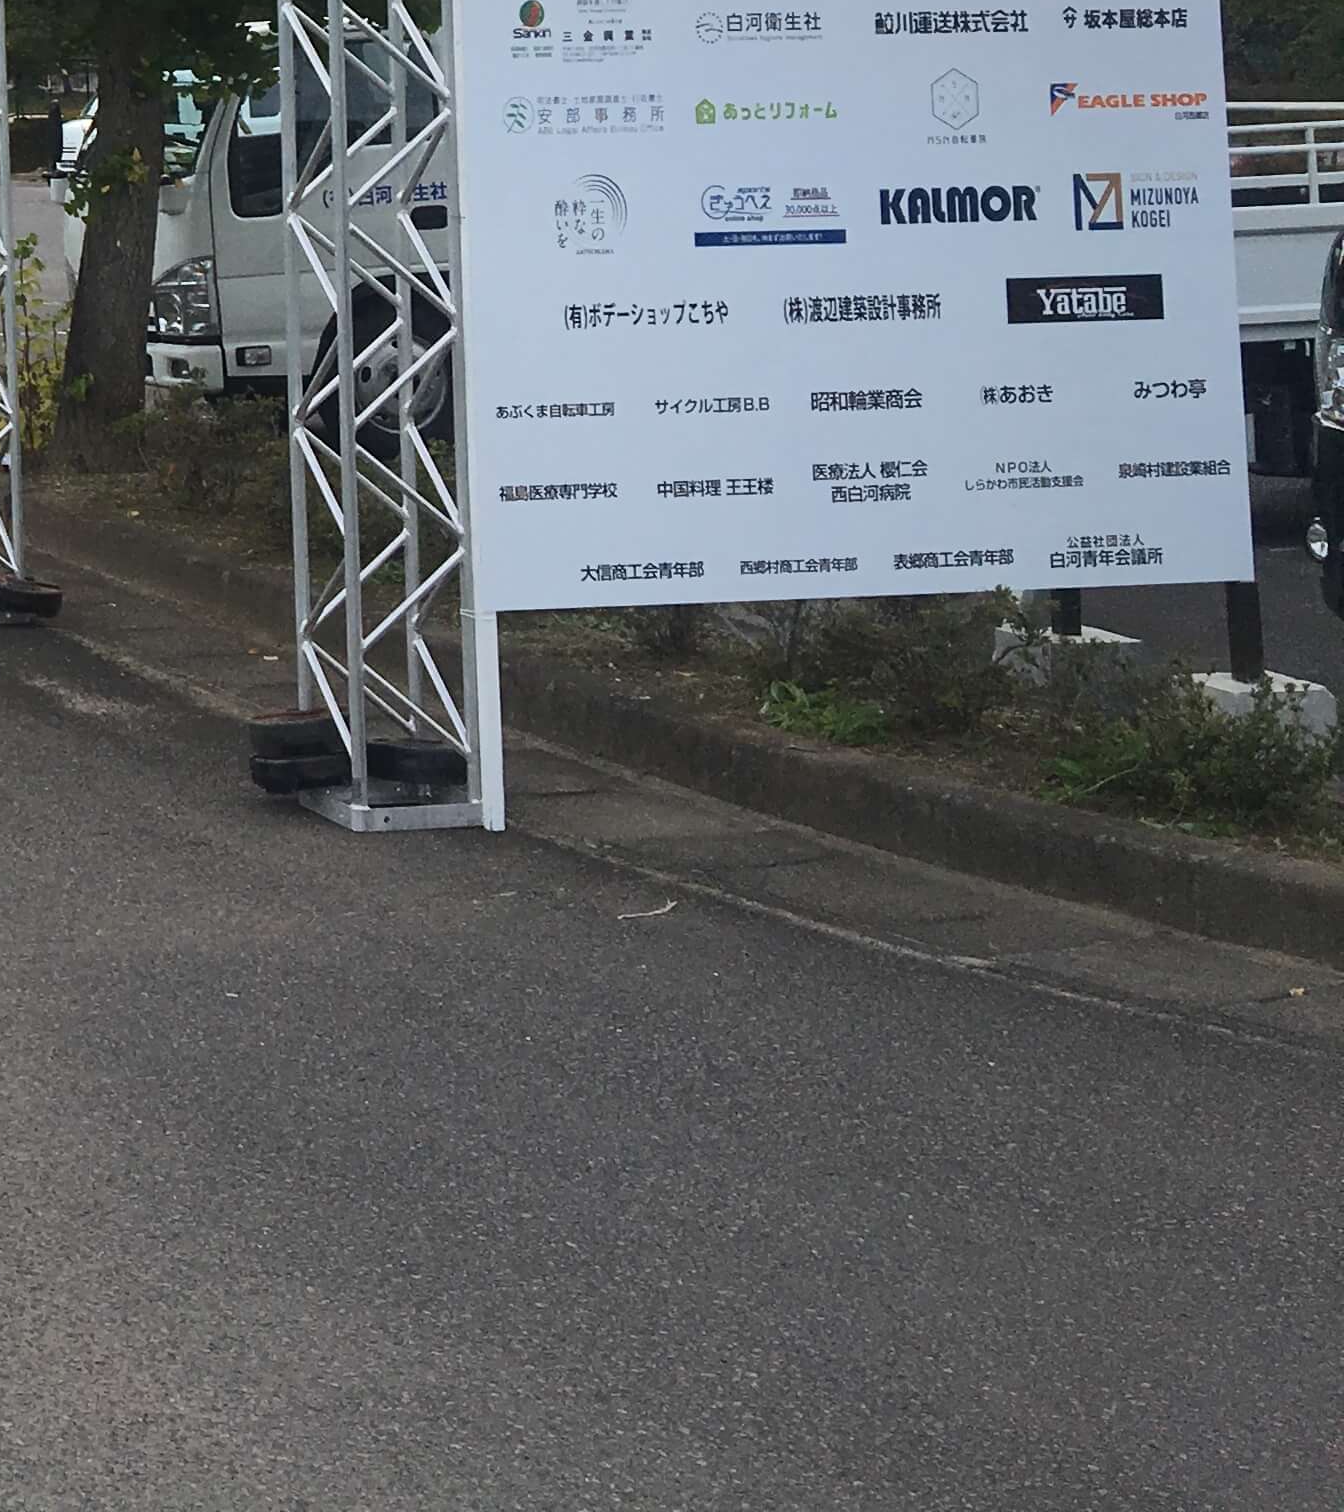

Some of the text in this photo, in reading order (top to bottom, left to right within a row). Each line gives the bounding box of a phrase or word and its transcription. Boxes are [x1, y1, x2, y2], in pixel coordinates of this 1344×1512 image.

[727, 11, 822, 32] 白河衛生社
[723, 101, 838, 120] あっとリフォーム
[1078, 93, 1207, 108] EAGLE SHOP
[879, 185, 1037, 225] KALMOR
[1130, 186, 1199, 206] MIZUNOYA
[1131, 209, 1171, 228] KOGEI
[1036, 286, 1127, 315] Yatabe
[1134, 378, 1207, 399] みつわ亭
[655, 397, 770, 415] サイクル工房B.B
[811, 388, 923, 412] 昭和輪業商会
[496, 402, 615, 419] あぶくま自転車工房
[812, 461, 876, 481] 医療法人
[995, 460, 1052, 473] NPO法人
[657, 479, 722, 498] 中国料理
[831, 483, 912, 503] 西白河病院
[1050, 547, 1163, 569] 白河青年会議所
[581, 561, 704, 583] 大信商工会青年部
